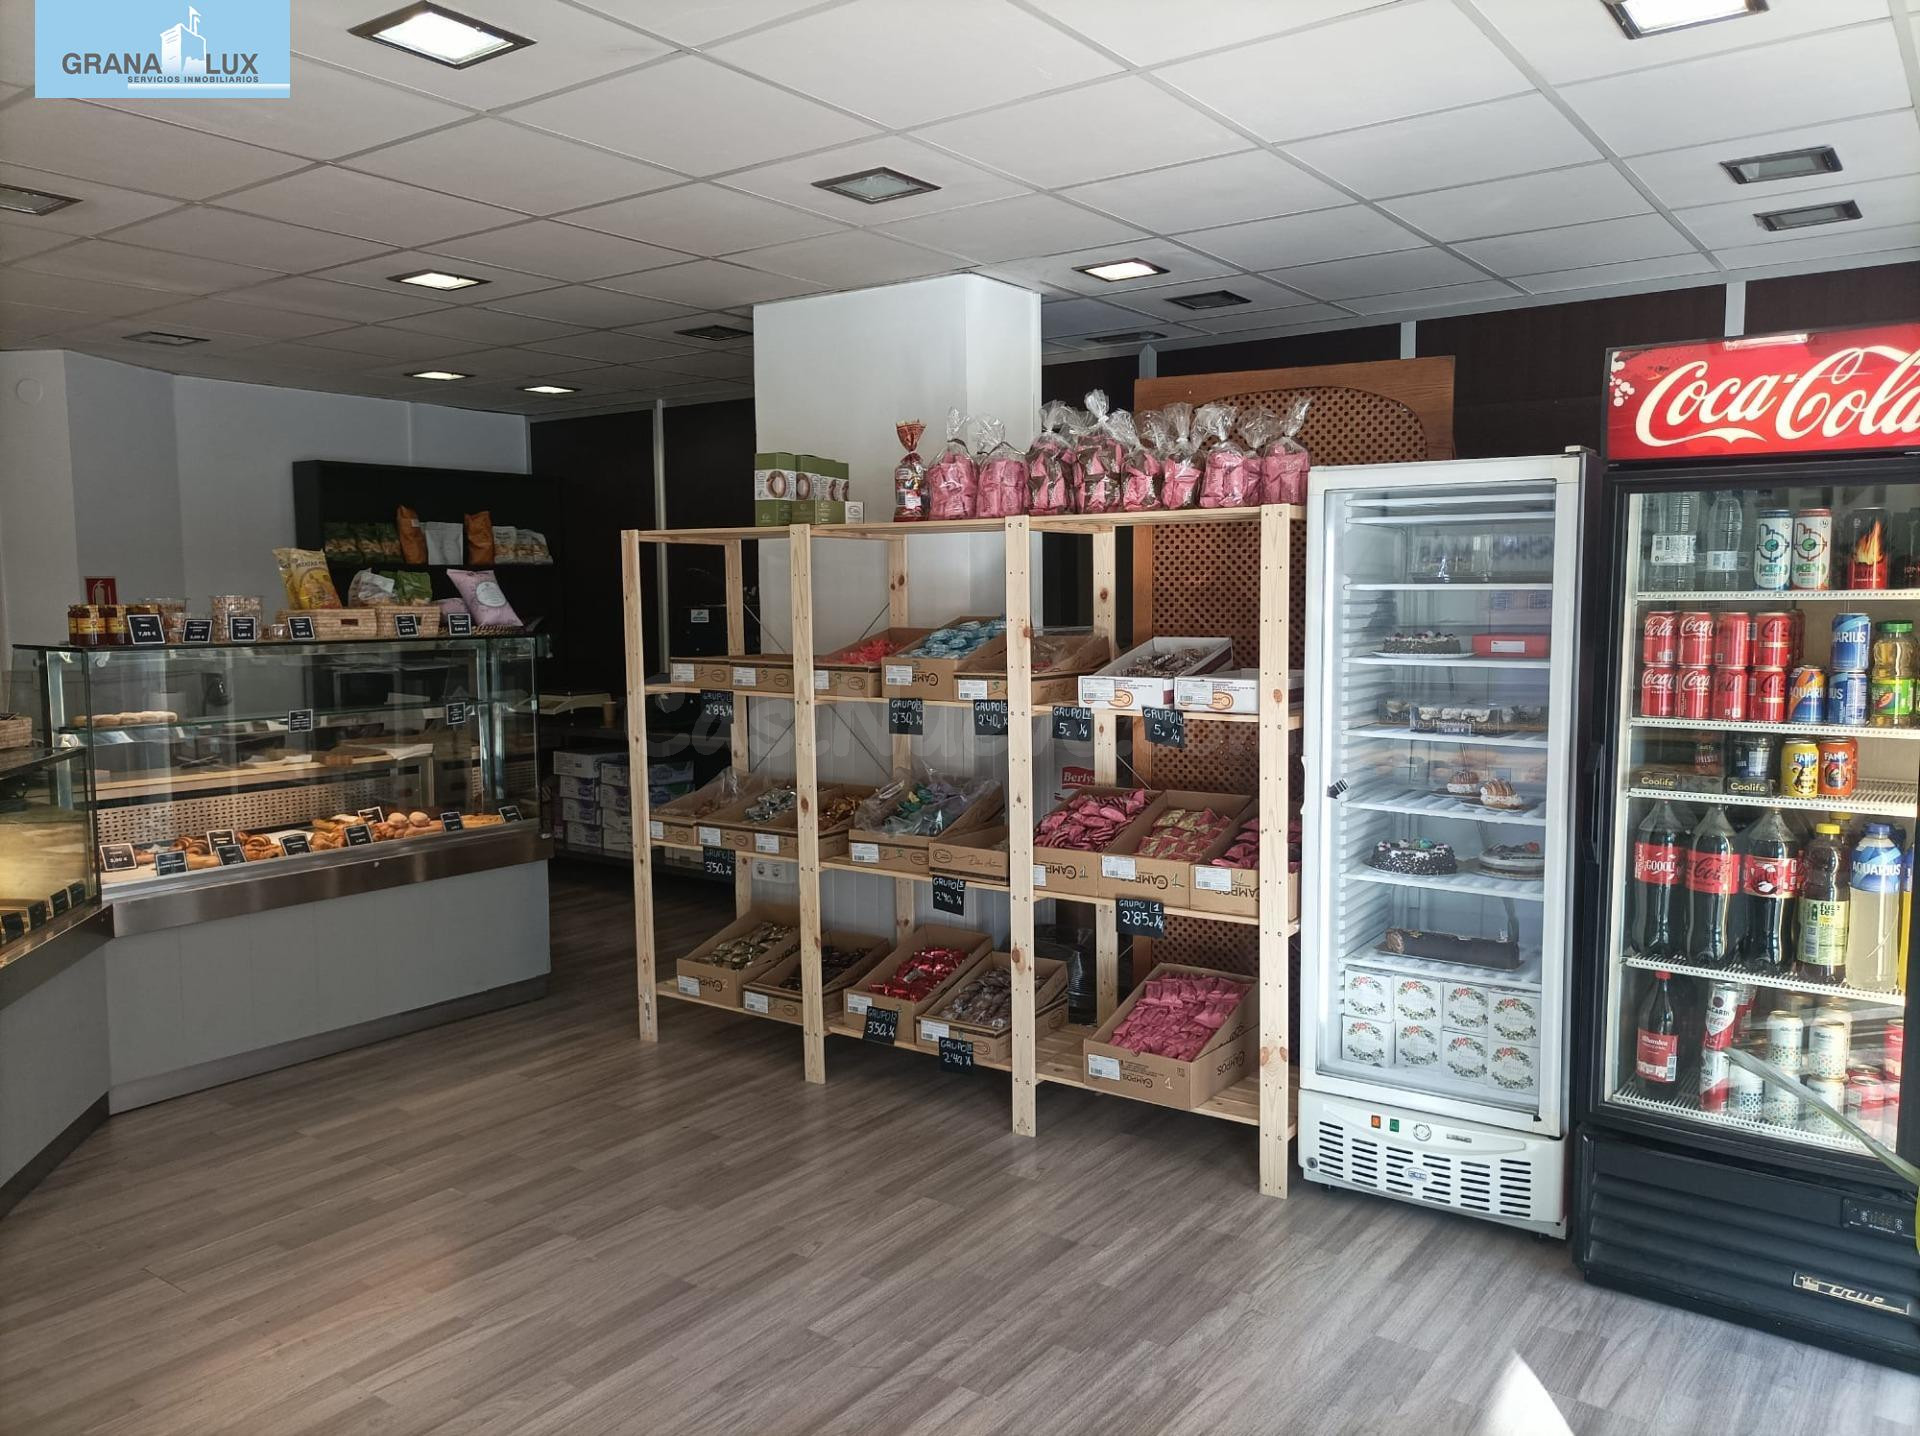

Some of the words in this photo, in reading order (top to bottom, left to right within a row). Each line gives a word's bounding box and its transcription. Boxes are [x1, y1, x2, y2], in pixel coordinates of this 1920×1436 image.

[1635, 344, 1920, 447] Coca-Cola
[892, 699, 916, 709] GRUPO
[975, 701, 1001, 712] GRUPO
[1053, 706, 1083, 718] GRUPO
[1143, 708, 1176, 724] GRUPO
[1641, 776, 1674, 786] Coolife
[1730, 782, 1766, 792] Coolife
[933, 877, 957, 890] GRUPO
[1119, 899, 1146, 909] GRUPO
